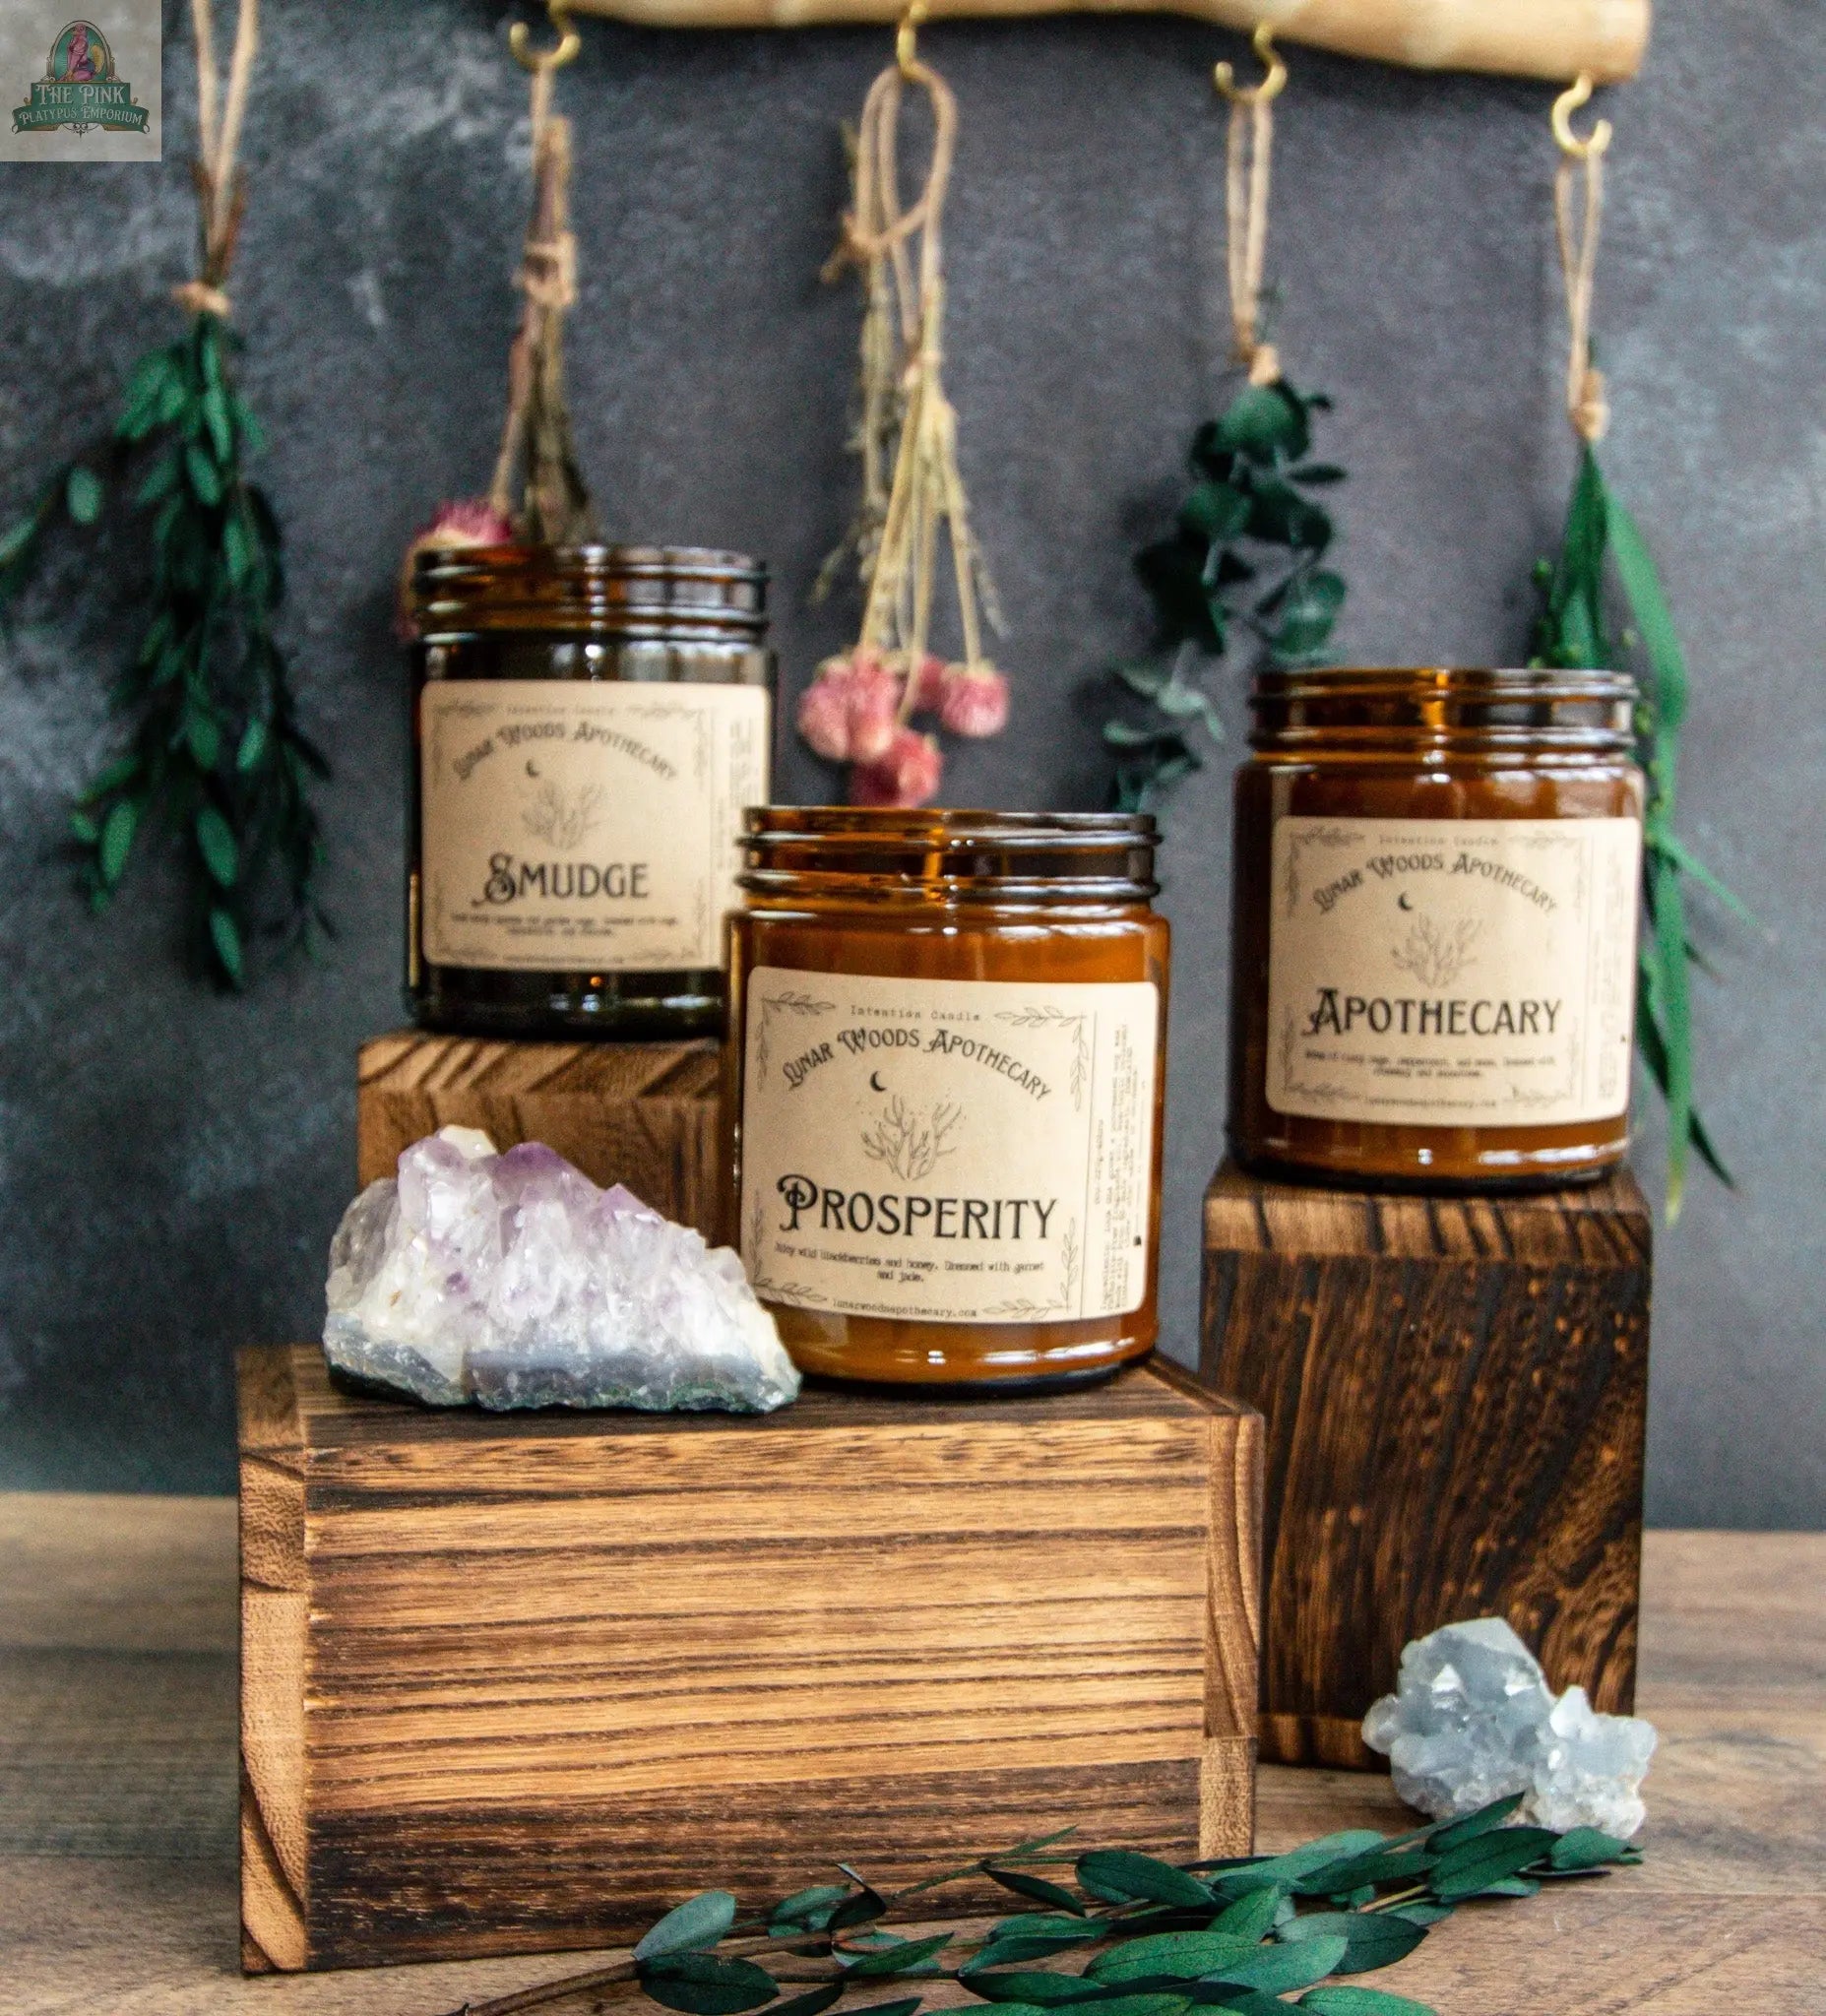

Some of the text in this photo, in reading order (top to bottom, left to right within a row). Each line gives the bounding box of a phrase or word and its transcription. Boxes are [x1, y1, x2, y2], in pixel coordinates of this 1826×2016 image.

[471, 852, 651, 908] SMUDGE
[1366, 852, 1444, 879] WOODS
[1448, 851, 1558, 914] APOTHECARY
[1300, 986, 1561, 1036] APOTHECARY
[783, 1026, 1052, 1101] LUNAR WOODS APOTHECARY
[776, 1173, 1058, 1240] PROSPERITY
